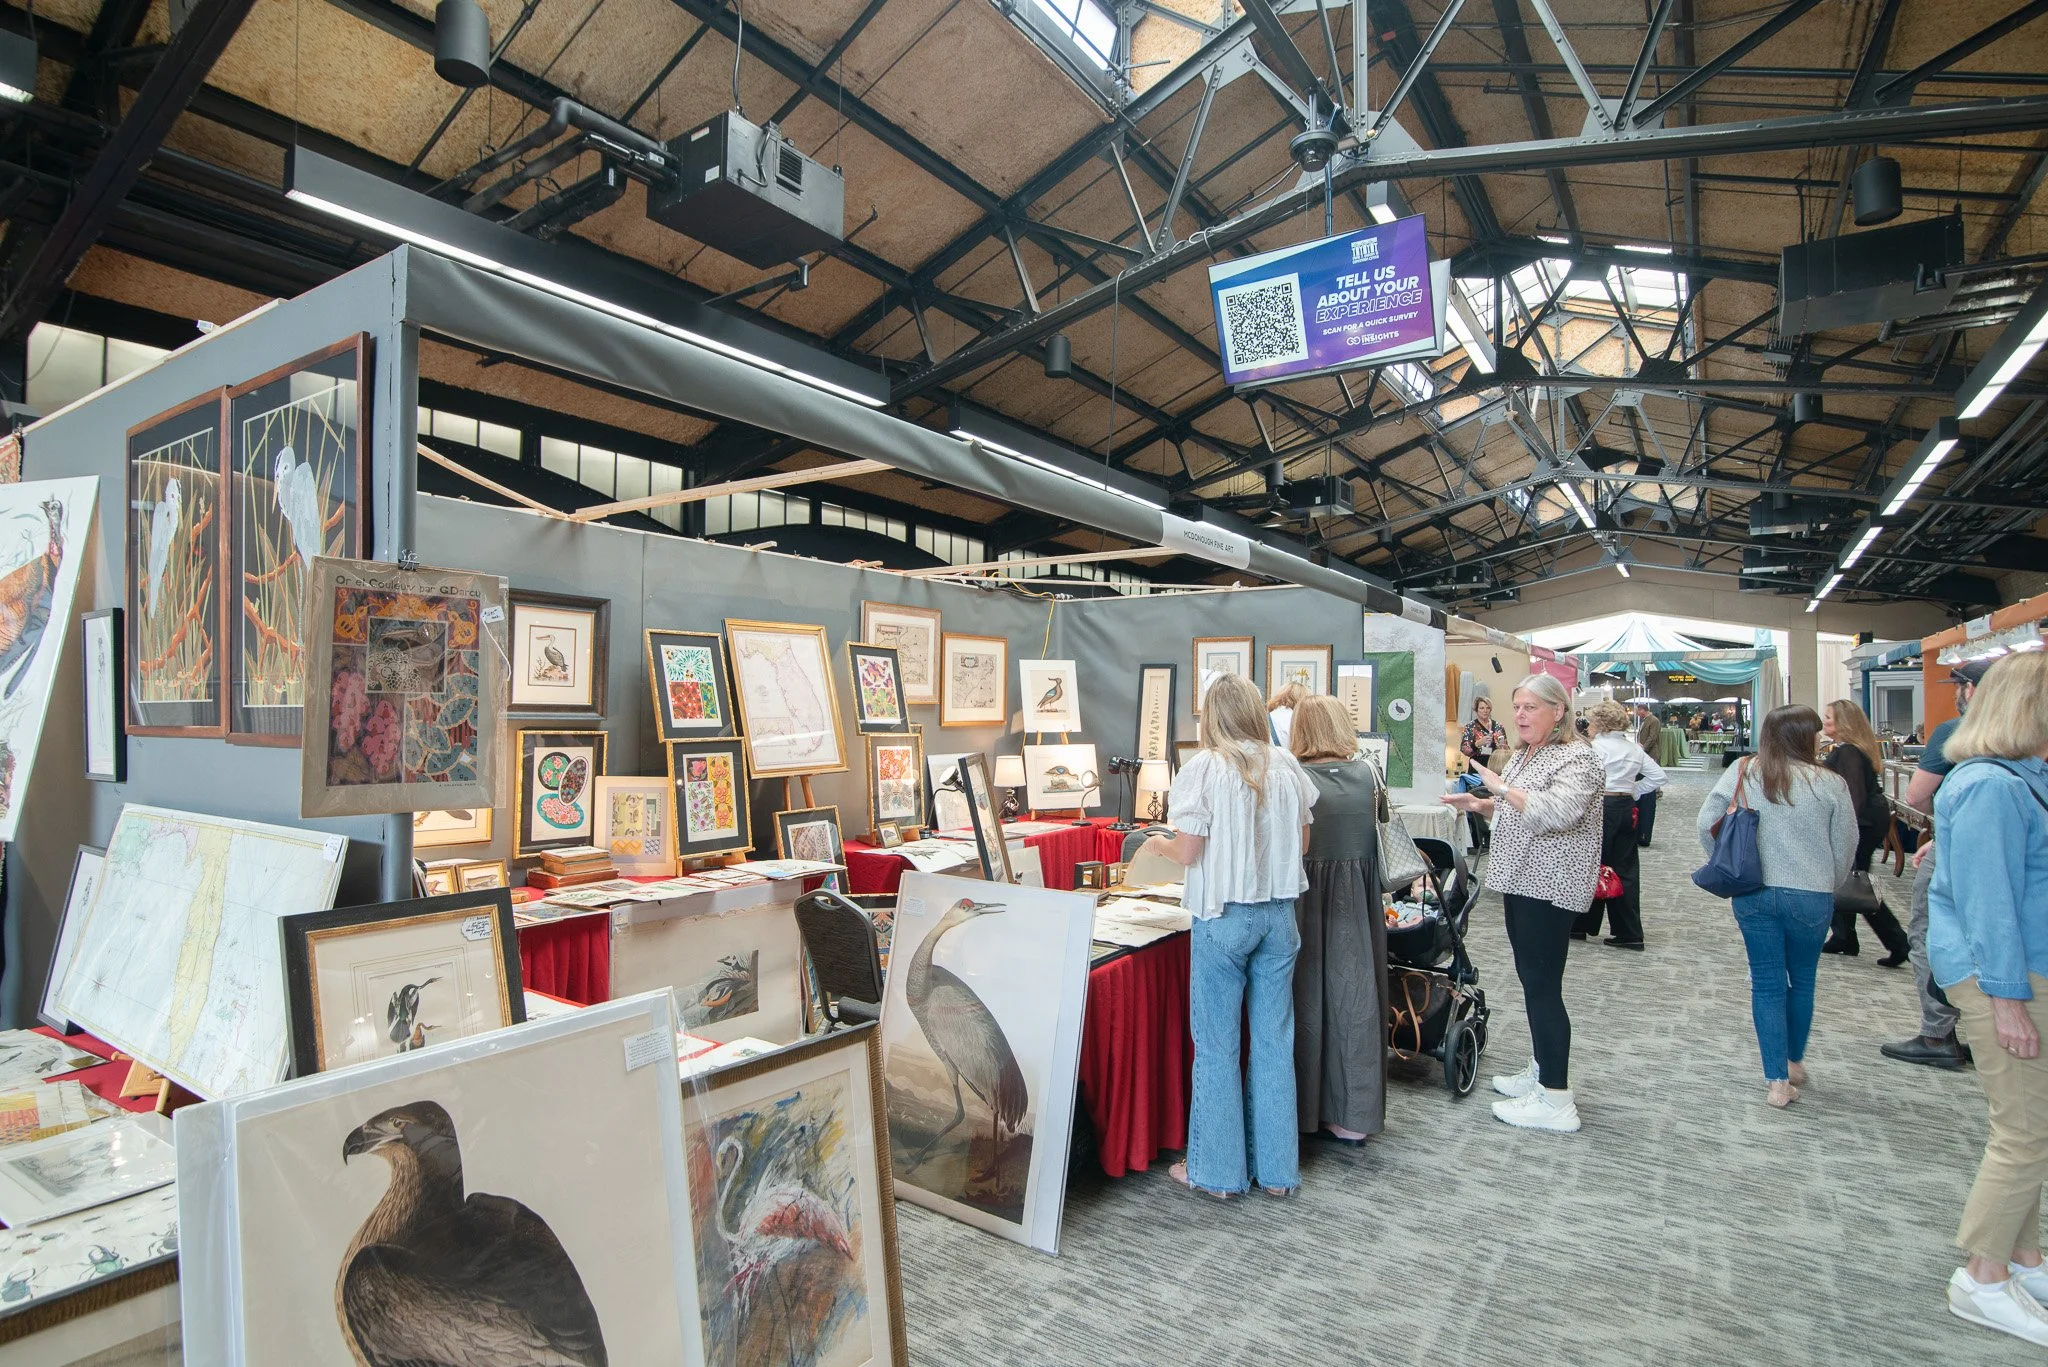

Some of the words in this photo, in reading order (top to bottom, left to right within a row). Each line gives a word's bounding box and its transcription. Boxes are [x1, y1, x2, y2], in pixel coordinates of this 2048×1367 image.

[1336, 271, 1370, 289] TELL
[1374, 265, 1396, 280] US
[1316, 285, 1371, 309] ABOUT
[1373, 275, 1419, 296] YOUR
[1315, 289, 1423, 323] EXPERIENCE
[1322, 326, 1342, 336] SCAN
[1343, 323, 1357, 332] FOR
[1357, 321, 1364, 329] A
[1365, 317, 1388, 327] QUICK
[1388, 311, 1419, 322] SURVEY
[1361, 330, 1399, 344] INSIGHTS
[1183, 531, 1214, 547] MCDONOUGH
[1214, 540, 1224, 551] FINE
[1224, 544, 1234, 554] ART
